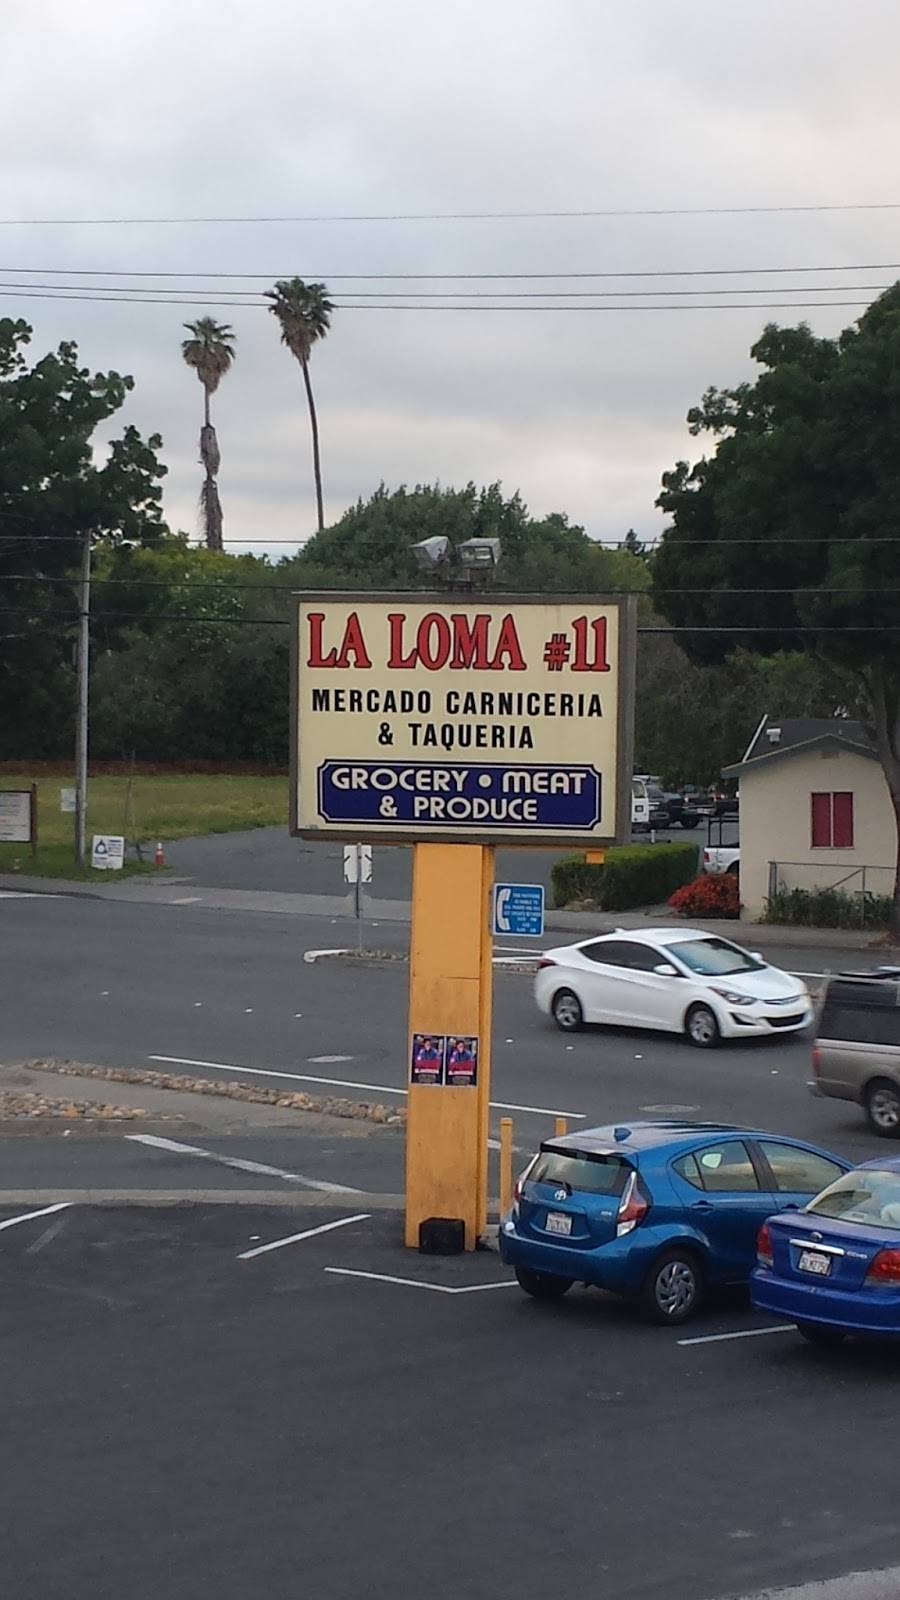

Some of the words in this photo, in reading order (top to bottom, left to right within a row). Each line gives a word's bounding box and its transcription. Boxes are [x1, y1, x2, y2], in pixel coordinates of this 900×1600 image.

[307, 612, 372, 669] LA
[387, 612, 527, 671] LOMA
[543, 615, 611, 672] #11
[312, 689, 431, 714] MERCADO
[446, 691, 603, 717] CARNICERIA
[378, 722, 393, 746] &
[408, 723, 534, 752] TAQUERIA
[331, 767, 468, 792] GROCERY
[502, 771, 587, 795] MEAT
[379, 796, 398, 818] &
[414, 797, 538, 821] PRODUCE
